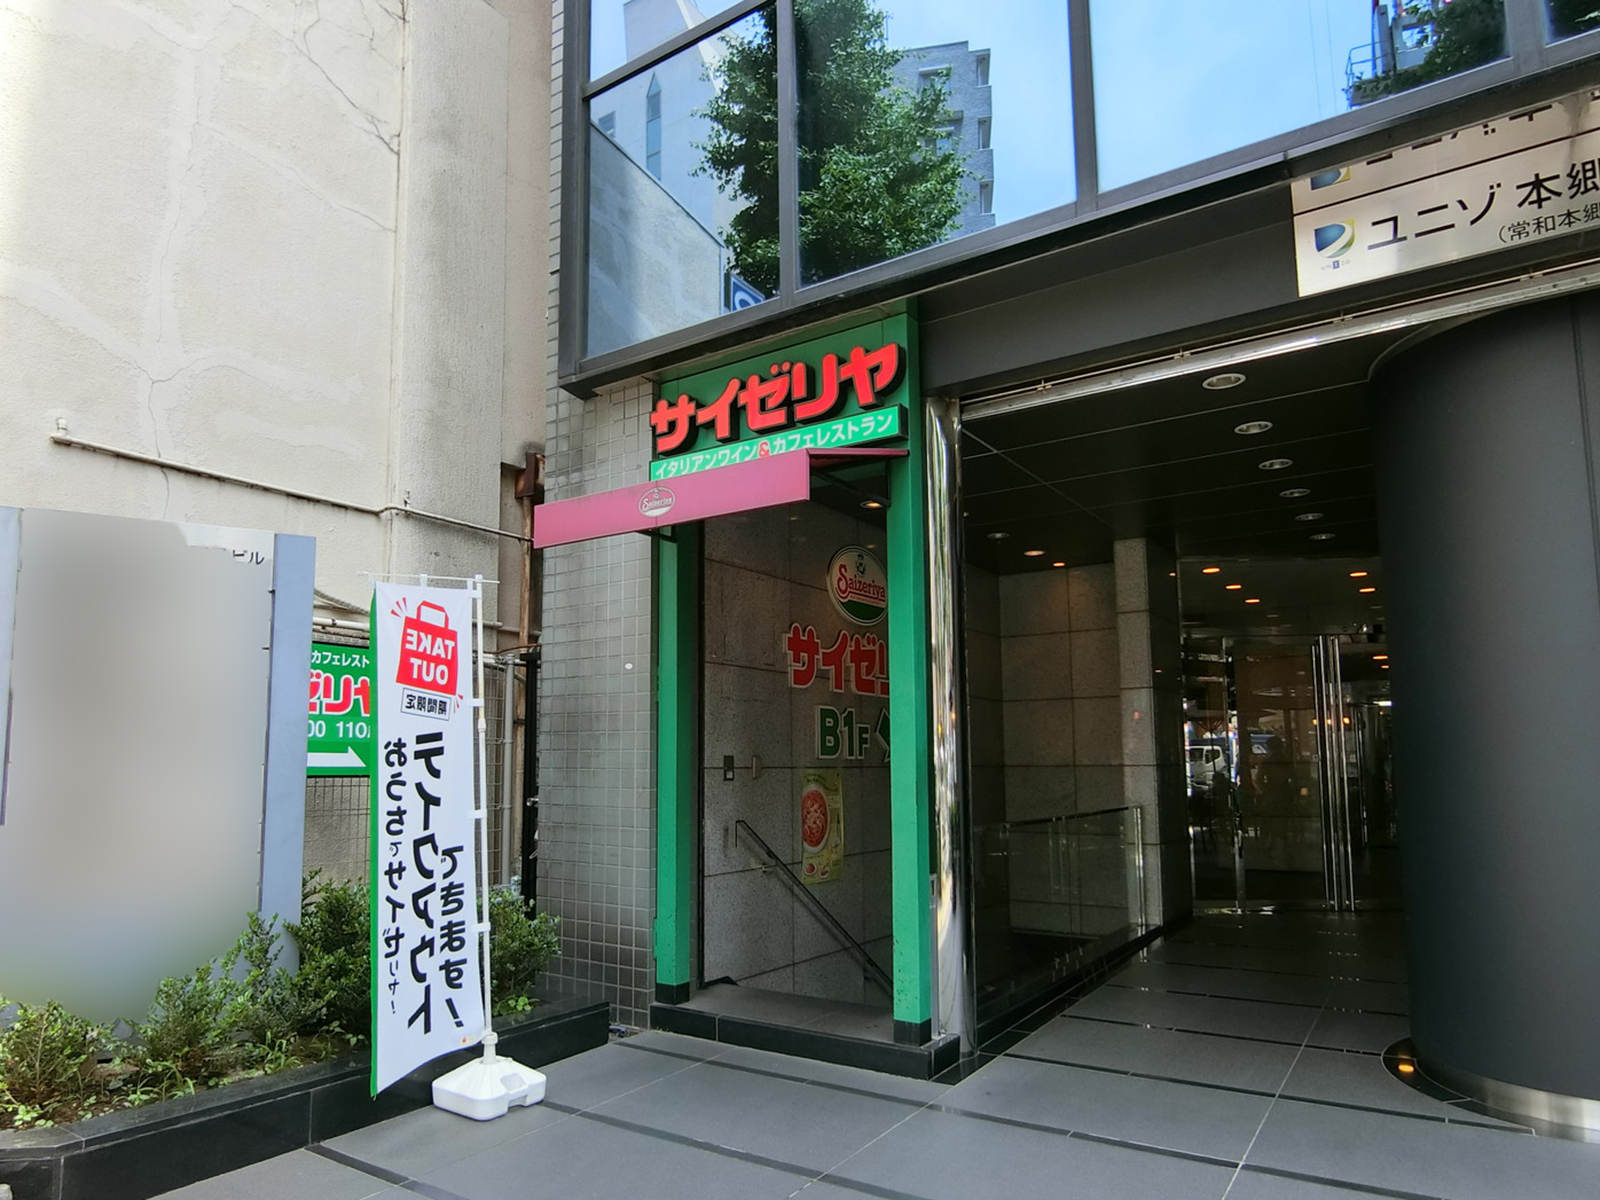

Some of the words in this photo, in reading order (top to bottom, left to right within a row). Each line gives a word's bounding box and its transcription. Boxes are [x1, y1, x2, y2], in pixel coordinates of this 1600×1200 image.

[650, 342, 901, 453] サイゼリヤ
[836, 563, 886, 600] Saizeriya
[336, 721, 370, 738] 110
[817, 705, 870, 759] B1F
